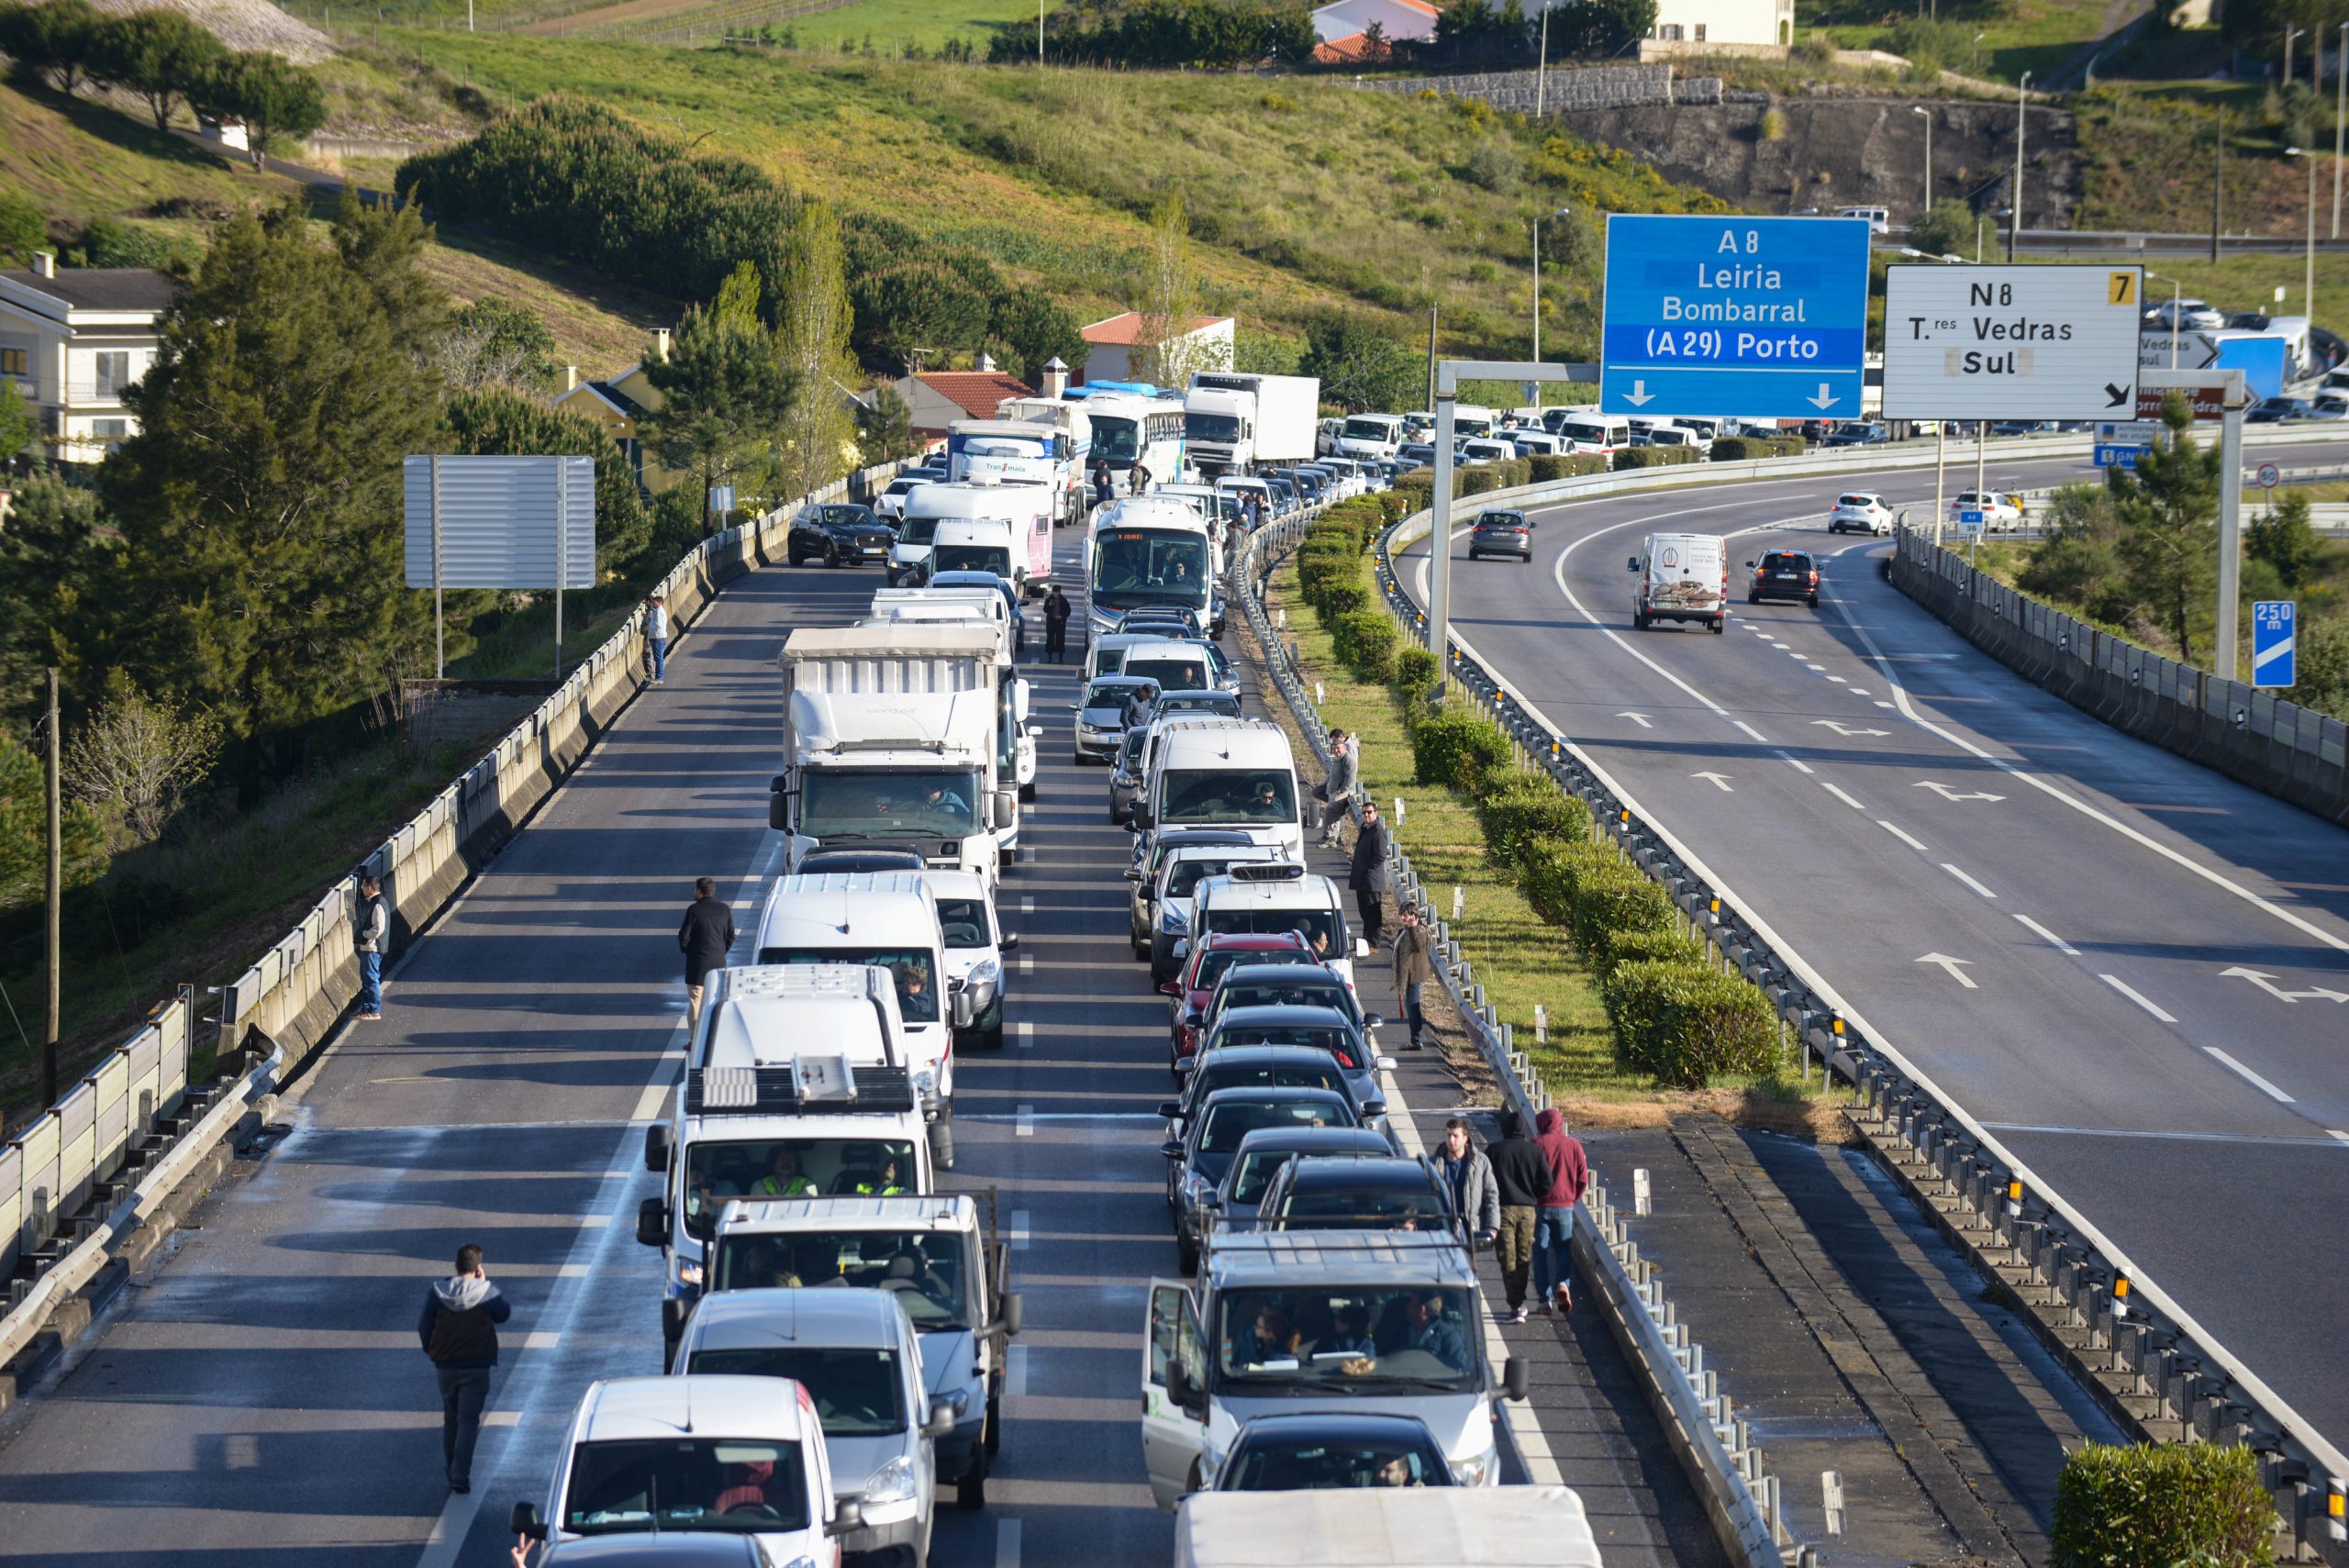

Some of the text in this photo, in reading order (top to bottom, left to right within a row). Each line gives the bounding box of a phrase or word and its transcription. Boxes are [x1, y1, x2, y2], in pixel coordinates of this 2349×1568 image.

[1698, 262, 1781, 290] Leiria
[2114, 275, 2130, 303] 7
[1663, 295, 1806, 323] Bombarral
[1973, 317, 2072, 340] Vedras
[1737, 332, 1819, 359] Porto
[1962, 350, 2015, 374] Sul
[2257, 603, 2292, 621] 250
[2266, 619, 2283, 630] m
